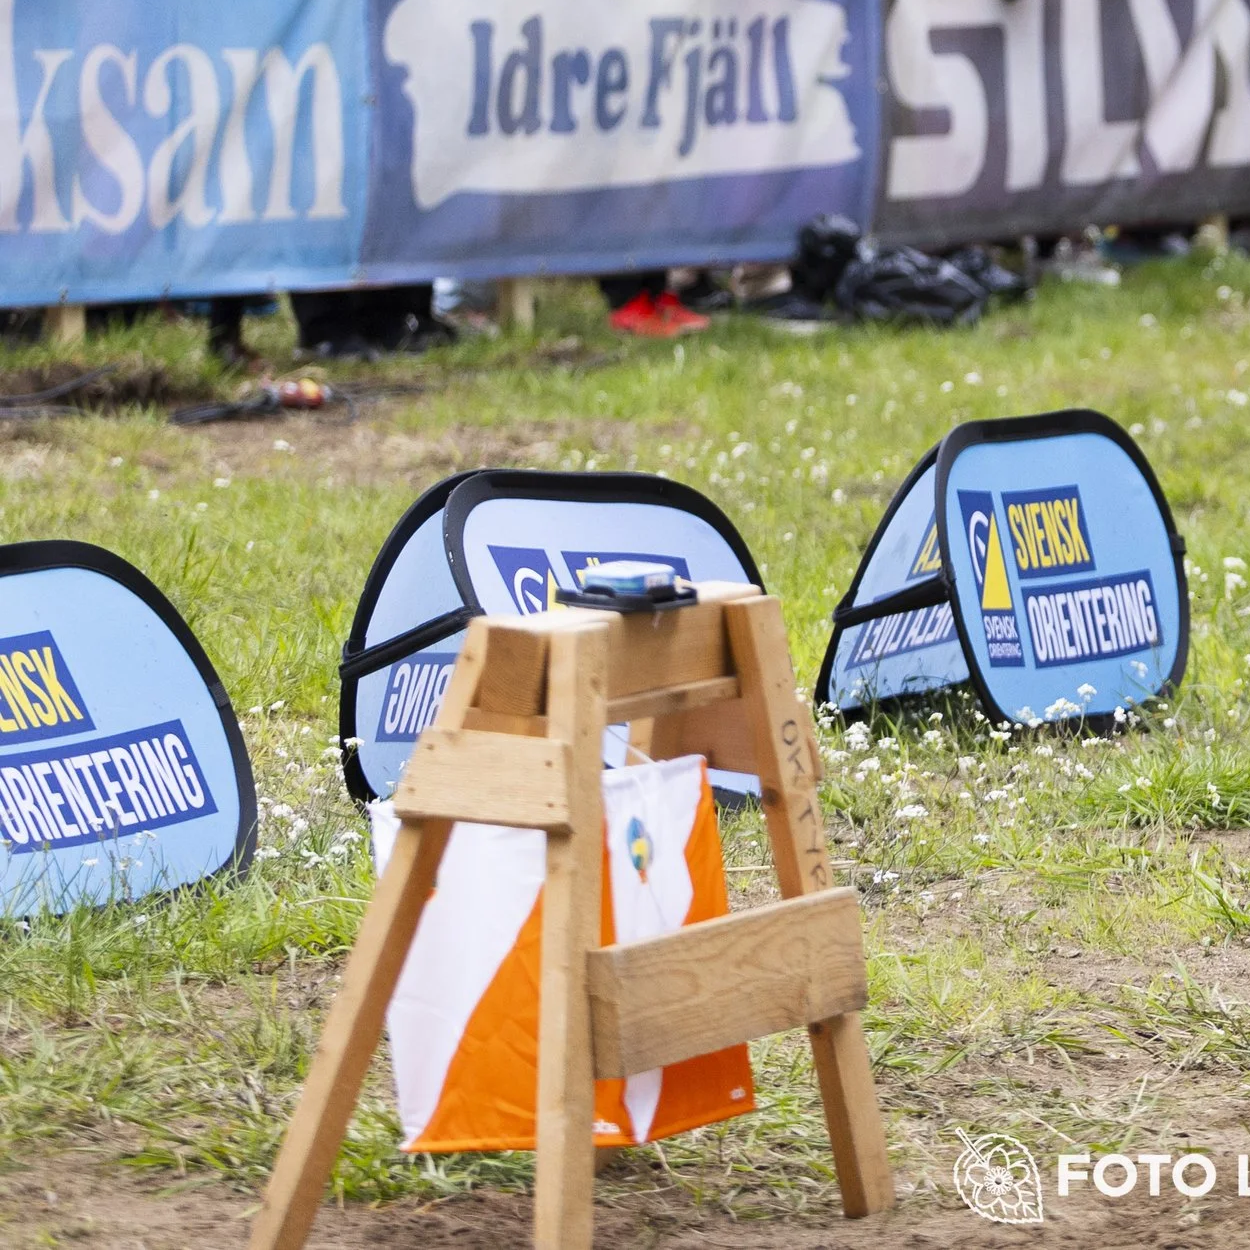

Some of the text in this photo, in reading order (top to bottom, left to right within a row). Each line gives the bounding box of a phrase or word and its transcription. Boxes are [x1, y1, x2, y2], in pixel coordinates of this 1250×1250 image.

[1008, 498, 1090, 570] SVENSK
[983, 615, 1019, 639] SVENSK
[1027, 580, 1158, 662] ORIENTERING
[0, 646, 84, 733] NSK
